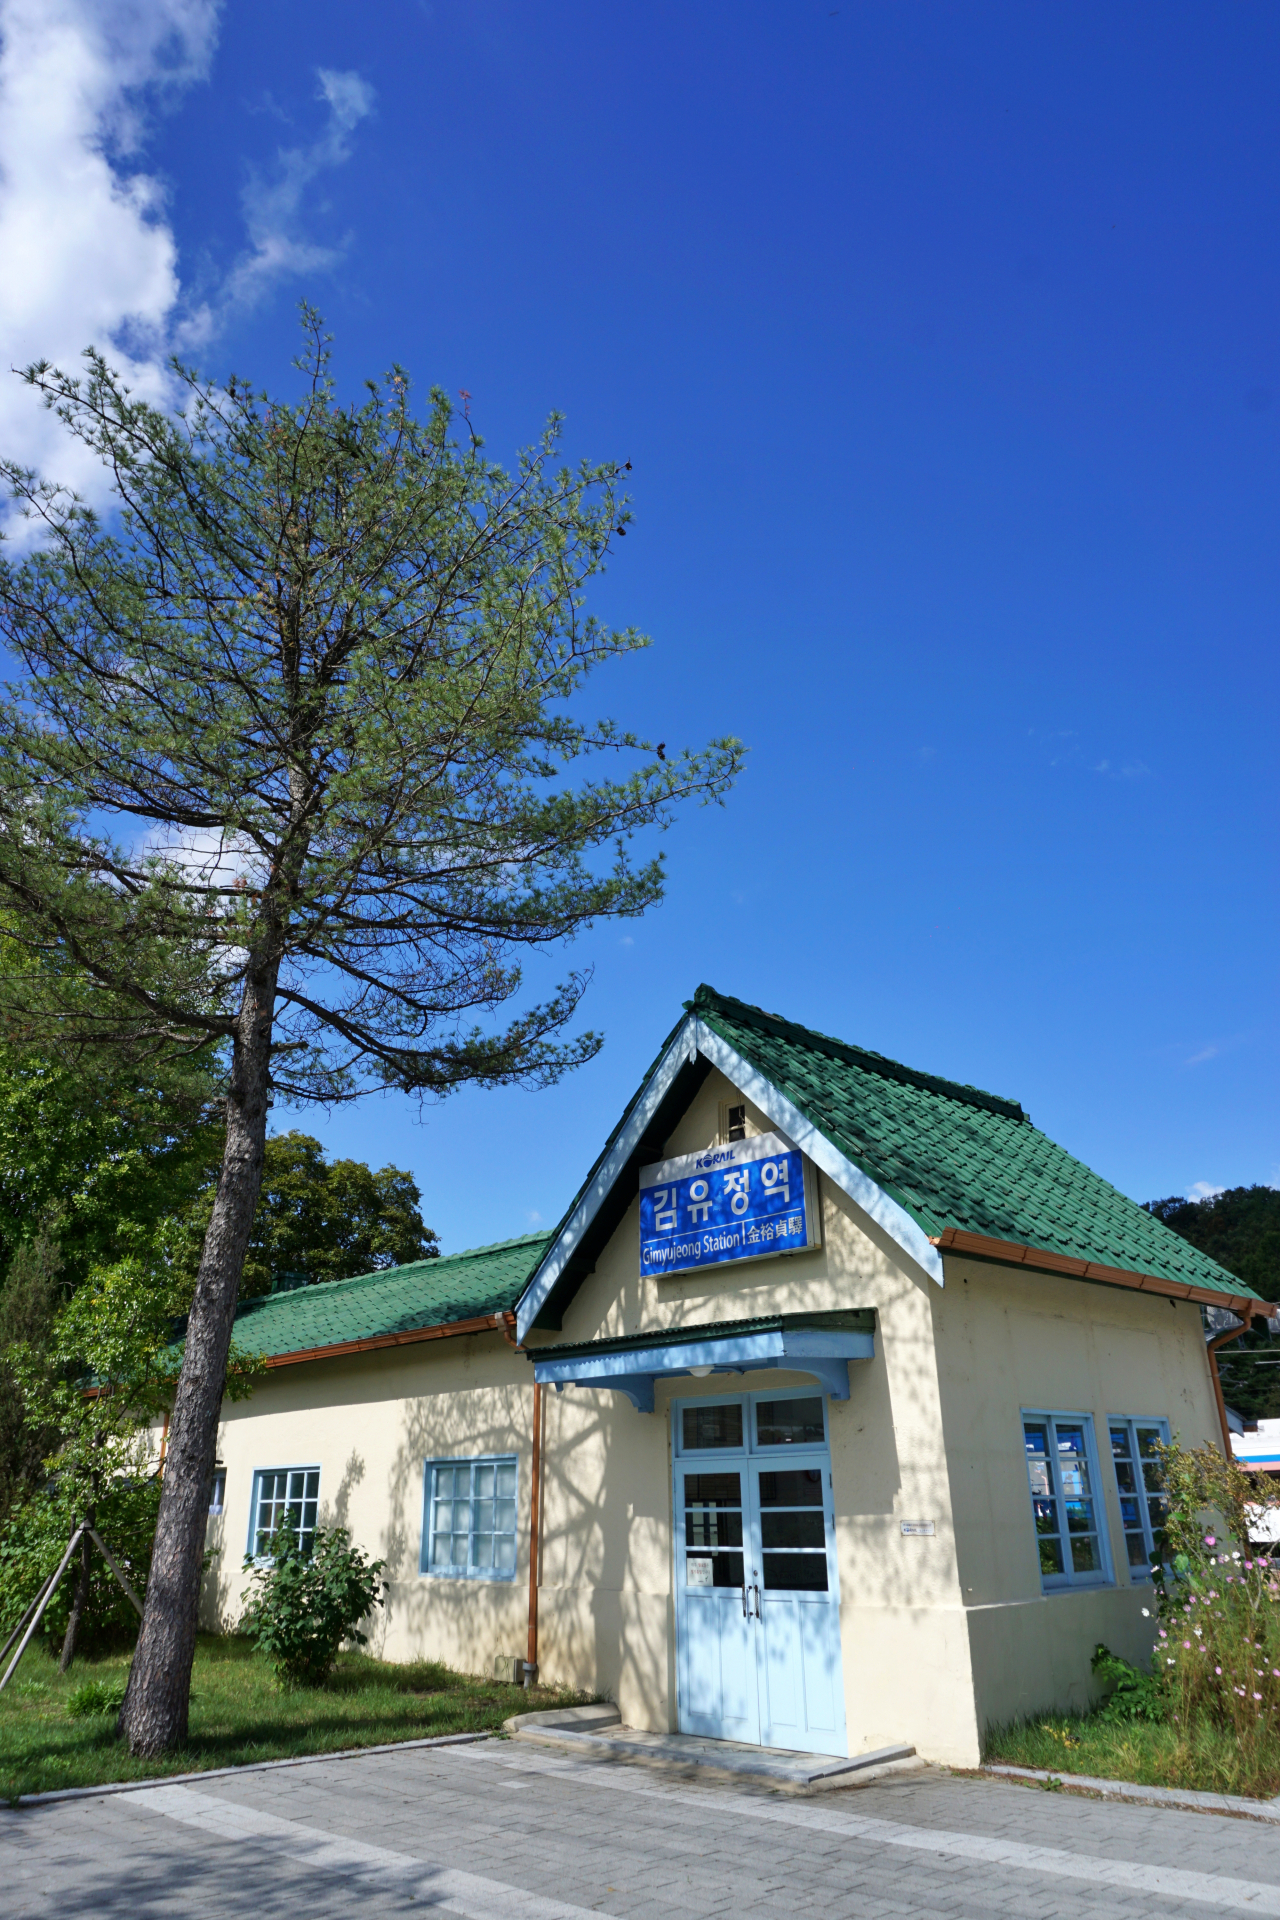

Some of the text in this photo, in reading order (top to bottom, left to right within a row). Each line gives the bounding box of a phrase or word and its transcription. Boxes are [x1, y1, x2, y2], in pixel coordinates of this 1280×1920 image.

[695, 1150, 735, 1169] KORAIL
[653, 1159, 790, 1231] 김유정역
[747, 1215, 803, 1244] 金裕貞驛
[643, 1231, 740, 1266] Gimyujeong Station
